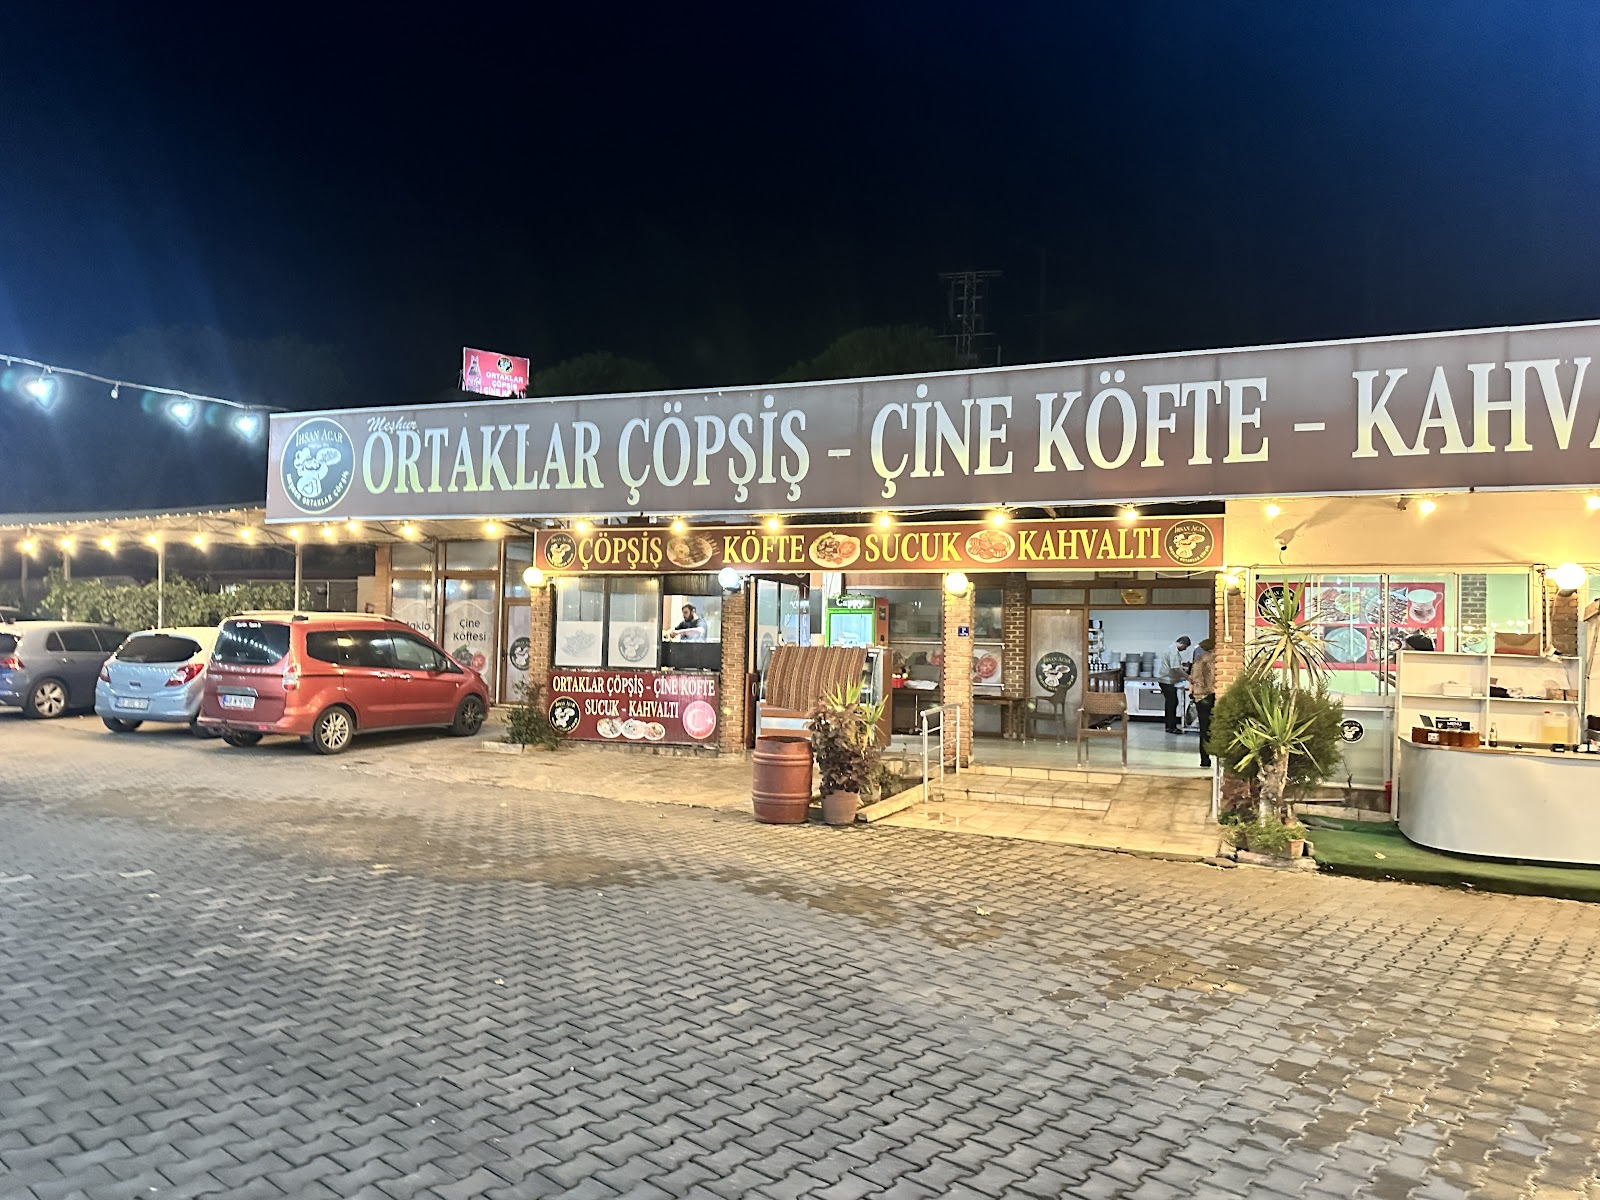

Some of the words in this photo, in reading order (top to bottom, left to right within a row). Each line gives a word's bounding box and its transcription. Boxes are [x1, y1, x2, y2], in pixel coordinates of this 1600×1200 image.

[362, 420, 604, 495] ORTAKLAR
[618, 394, 810, 505] ÇÖPŞİŞ
[870, 384, 1013, 499] ÇİNE
[1034, 369, 1269, 473] KÖFTE
[1352, 357, 1600, 458] KAHV
[367, 416, 417, 434] Meşhur
[578, 531, 663, 570] ÇÖPŞİŞ
[723, 530, 805, 564] KÖFTE
[864, 532, 963, 563] SUCUK
[1017, 526, 1162, 560] KAHVALTI
[459, 618, 481, 629] Çine
[453, 630, 486, 643] Köftesi
[552, 677, 604, 693] ORTAKLAR
[606, 674, 644, 697] ÇÖPŞİŞ
[653, 675, 679, 698] ÇİNE
[680, 675, 716, 697] KÖFTE
[584, 699, 619, 717] SUCUK
[628, 700, 679, 719] KAHVALTI
